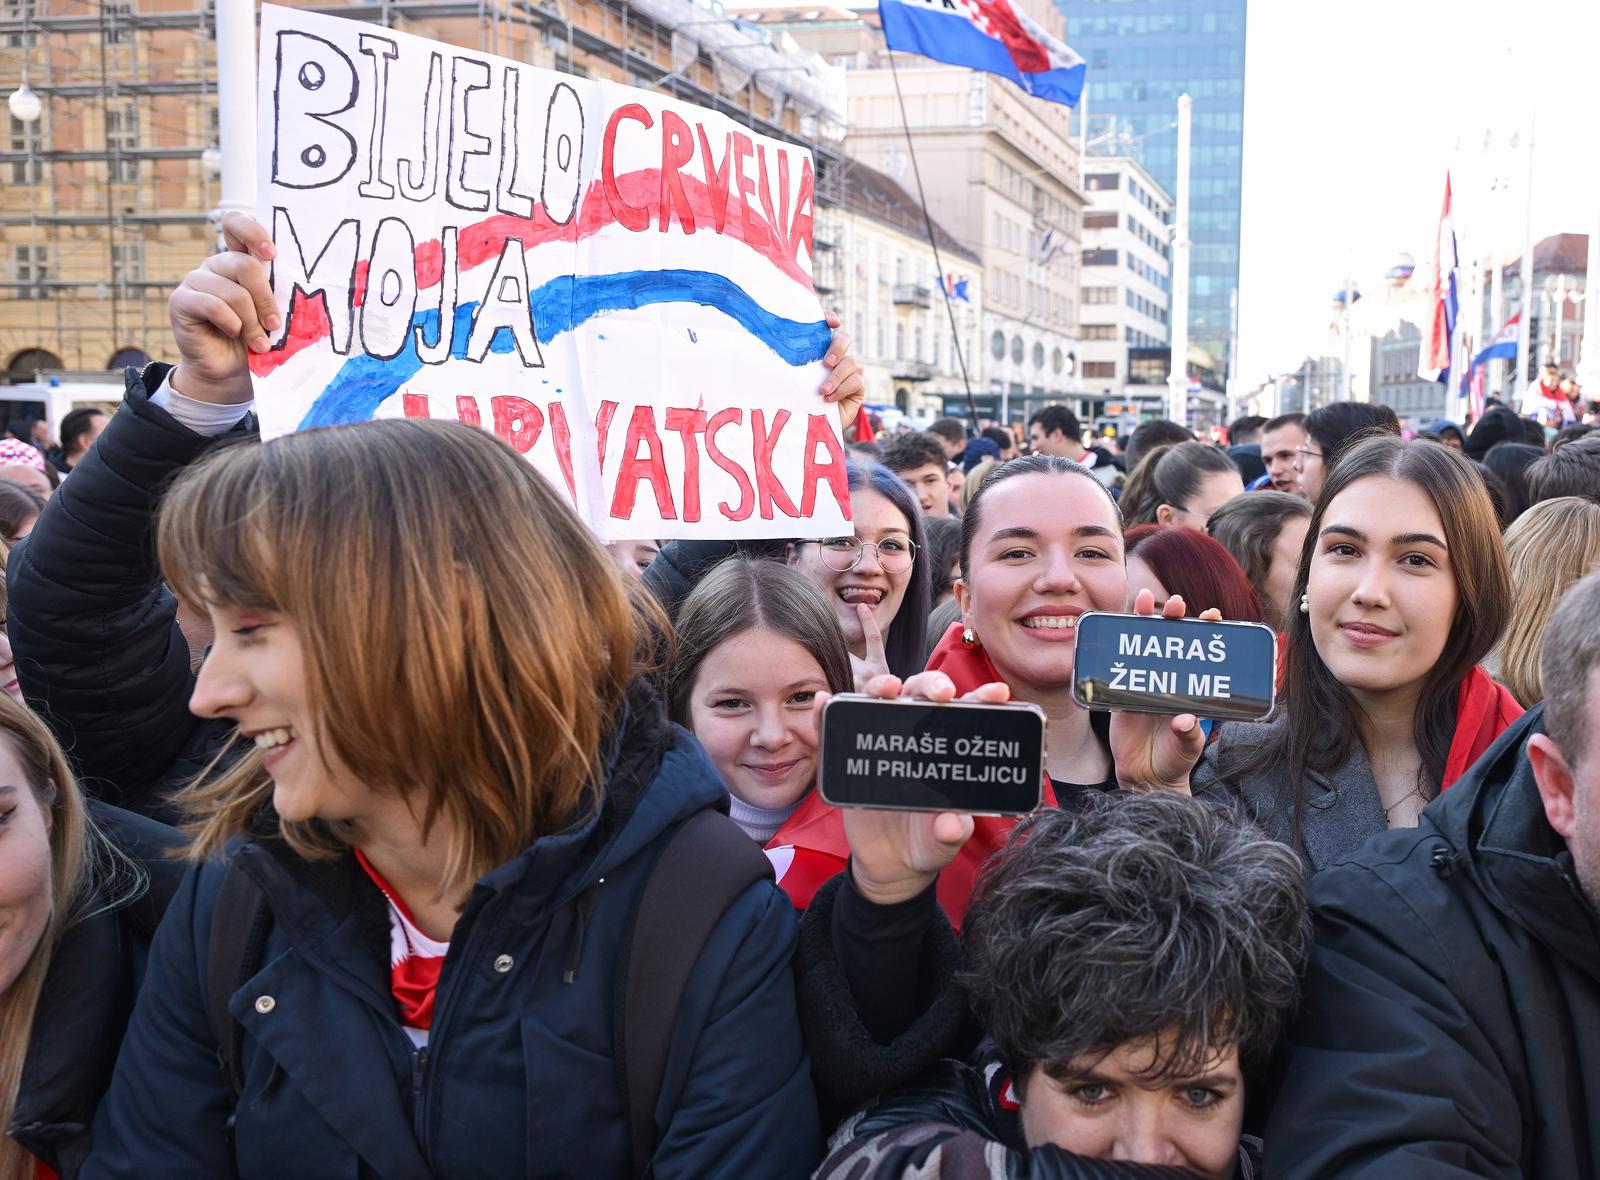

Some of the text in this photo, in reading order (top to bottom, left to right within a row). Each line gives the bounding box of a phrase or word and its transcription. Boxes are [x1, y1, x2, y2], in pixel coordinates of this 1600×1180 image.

[271, 29, 815, 262] BIJELO CRVENA
[267, 206, 545, 368] MOJA
[402, 393, 853, 524] RVATSKA
[1118, 633, 1227, 663] MARAŠ
[1108, 661, 1232, 698] ŽENI ME
[856, 732, 1020, 759] MARAŠE OŽENI
[846, 758, 1027, 785] MI PRIJATELJICU
